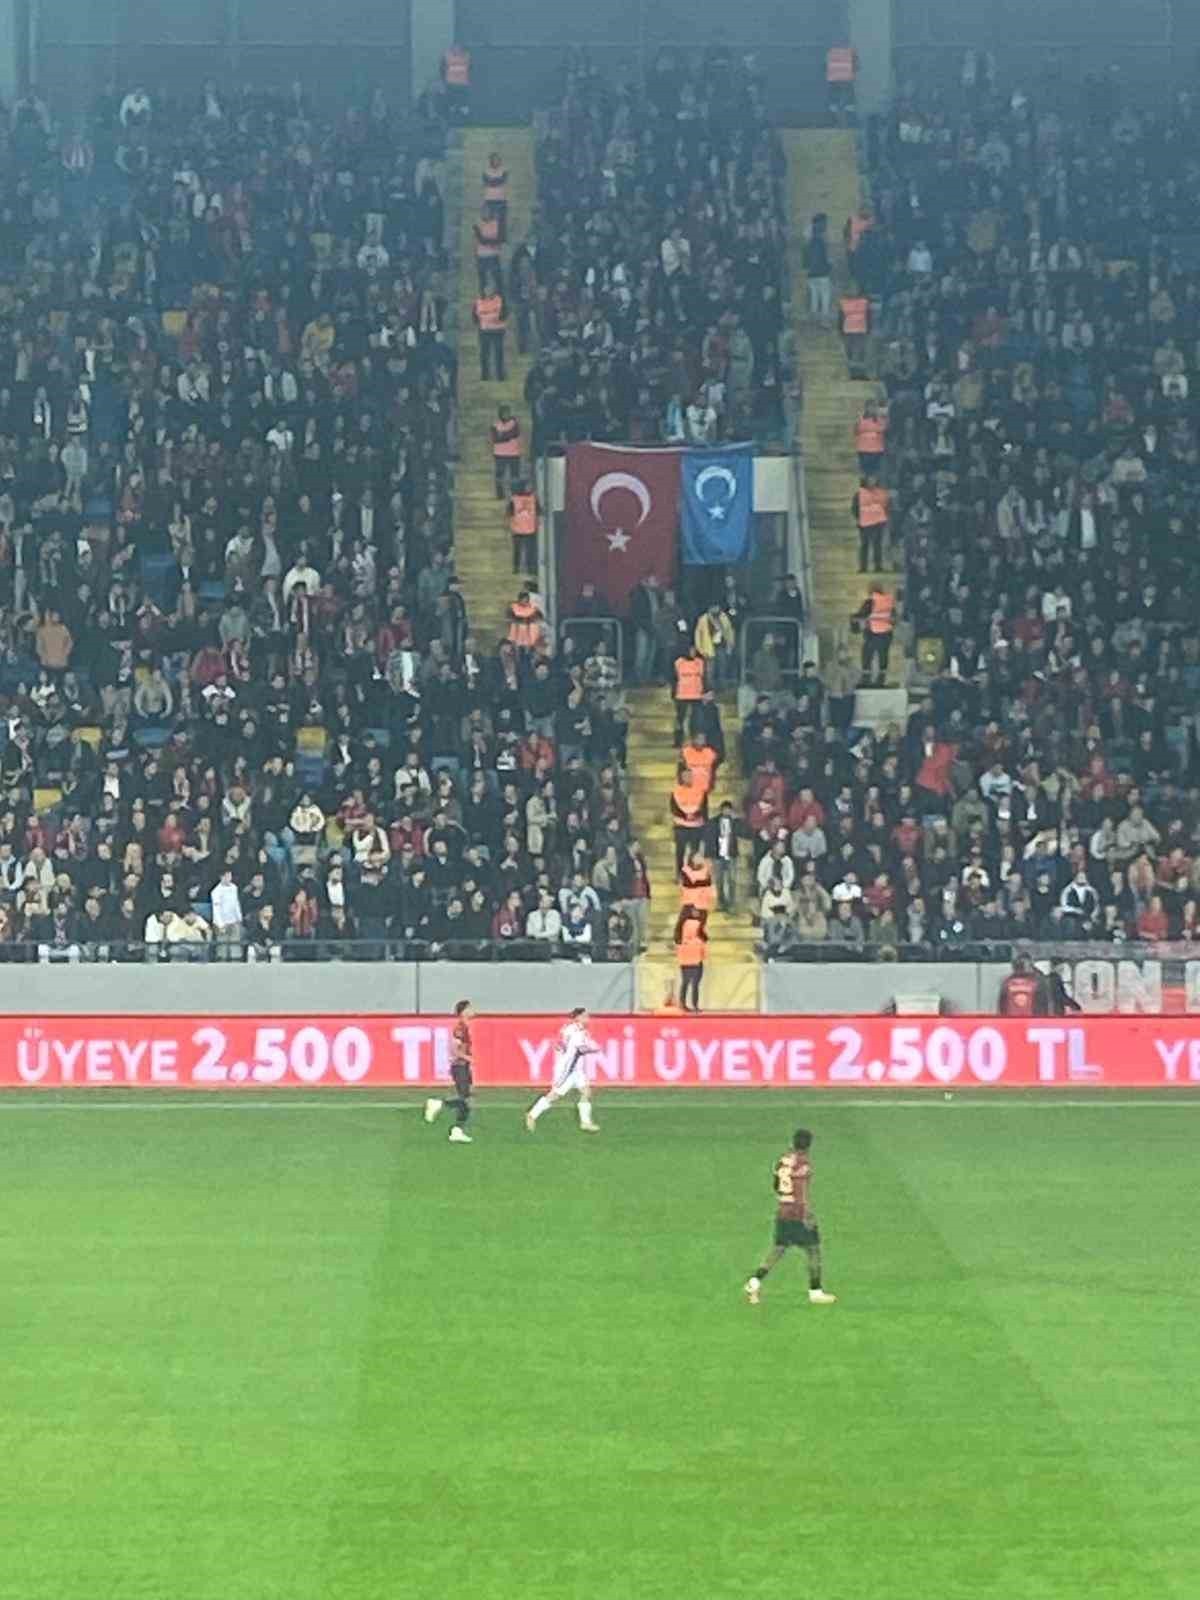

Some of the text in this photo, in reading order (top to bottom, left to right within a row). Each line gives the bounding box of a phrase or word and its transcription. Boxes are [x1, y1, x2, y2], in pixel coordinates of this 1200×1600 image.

[16, 1027, 179, 1082] ÜYEYE
[191, 1026, 374, 1083] 2.500
[519, 1025, 1103, 1083] YNİ ÜYEYE 2.500 TL
